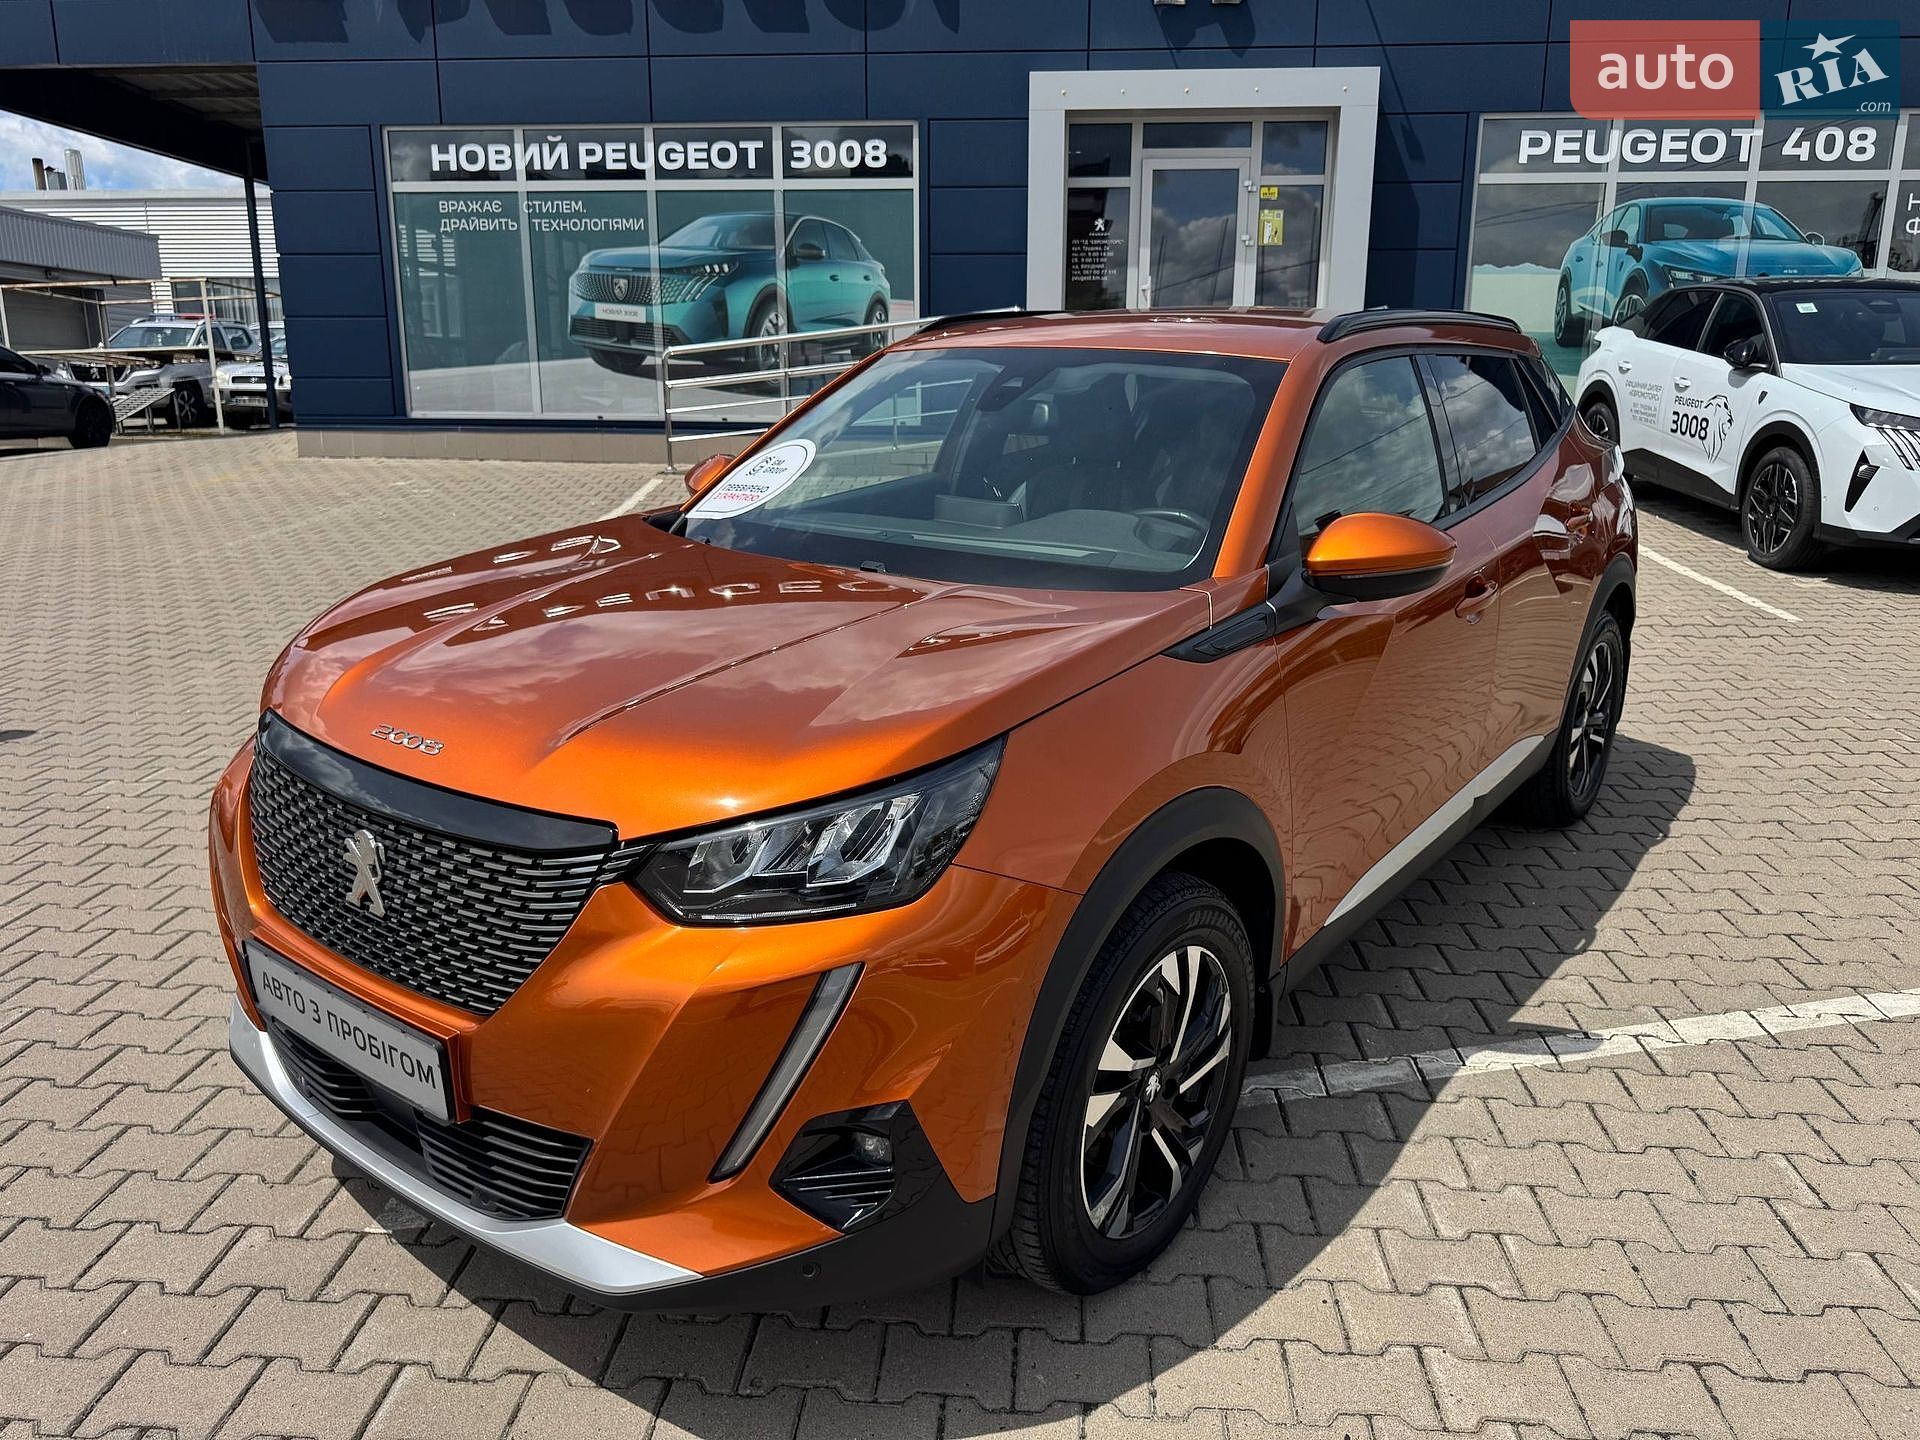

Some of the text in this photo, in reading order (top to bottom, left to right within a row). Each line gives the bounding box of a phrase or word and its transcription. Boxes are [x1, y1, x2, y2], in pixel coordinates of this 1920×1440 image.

[430, 135, 888, 172] НОВИЙ PEUGEOT 3008
[1518, 126, 1877, 164] PEUGEOT 408
[439, 200, 587, 213] ВРАЖАЄ СТИЛЕМ.
[440, 216, 645, 233] ДРАЙВИТЬ ТЕХНОЛОГІЯМИ
[1674, 395, 1704, 409] PEUGEOT
[1670, 411, 1709, 441] 3008
[370, 723, 445, 756] 2008
[262, 970, 306, 1015] АВТО
[326, 1009, 437, 1090] ПРОБІГОМ
